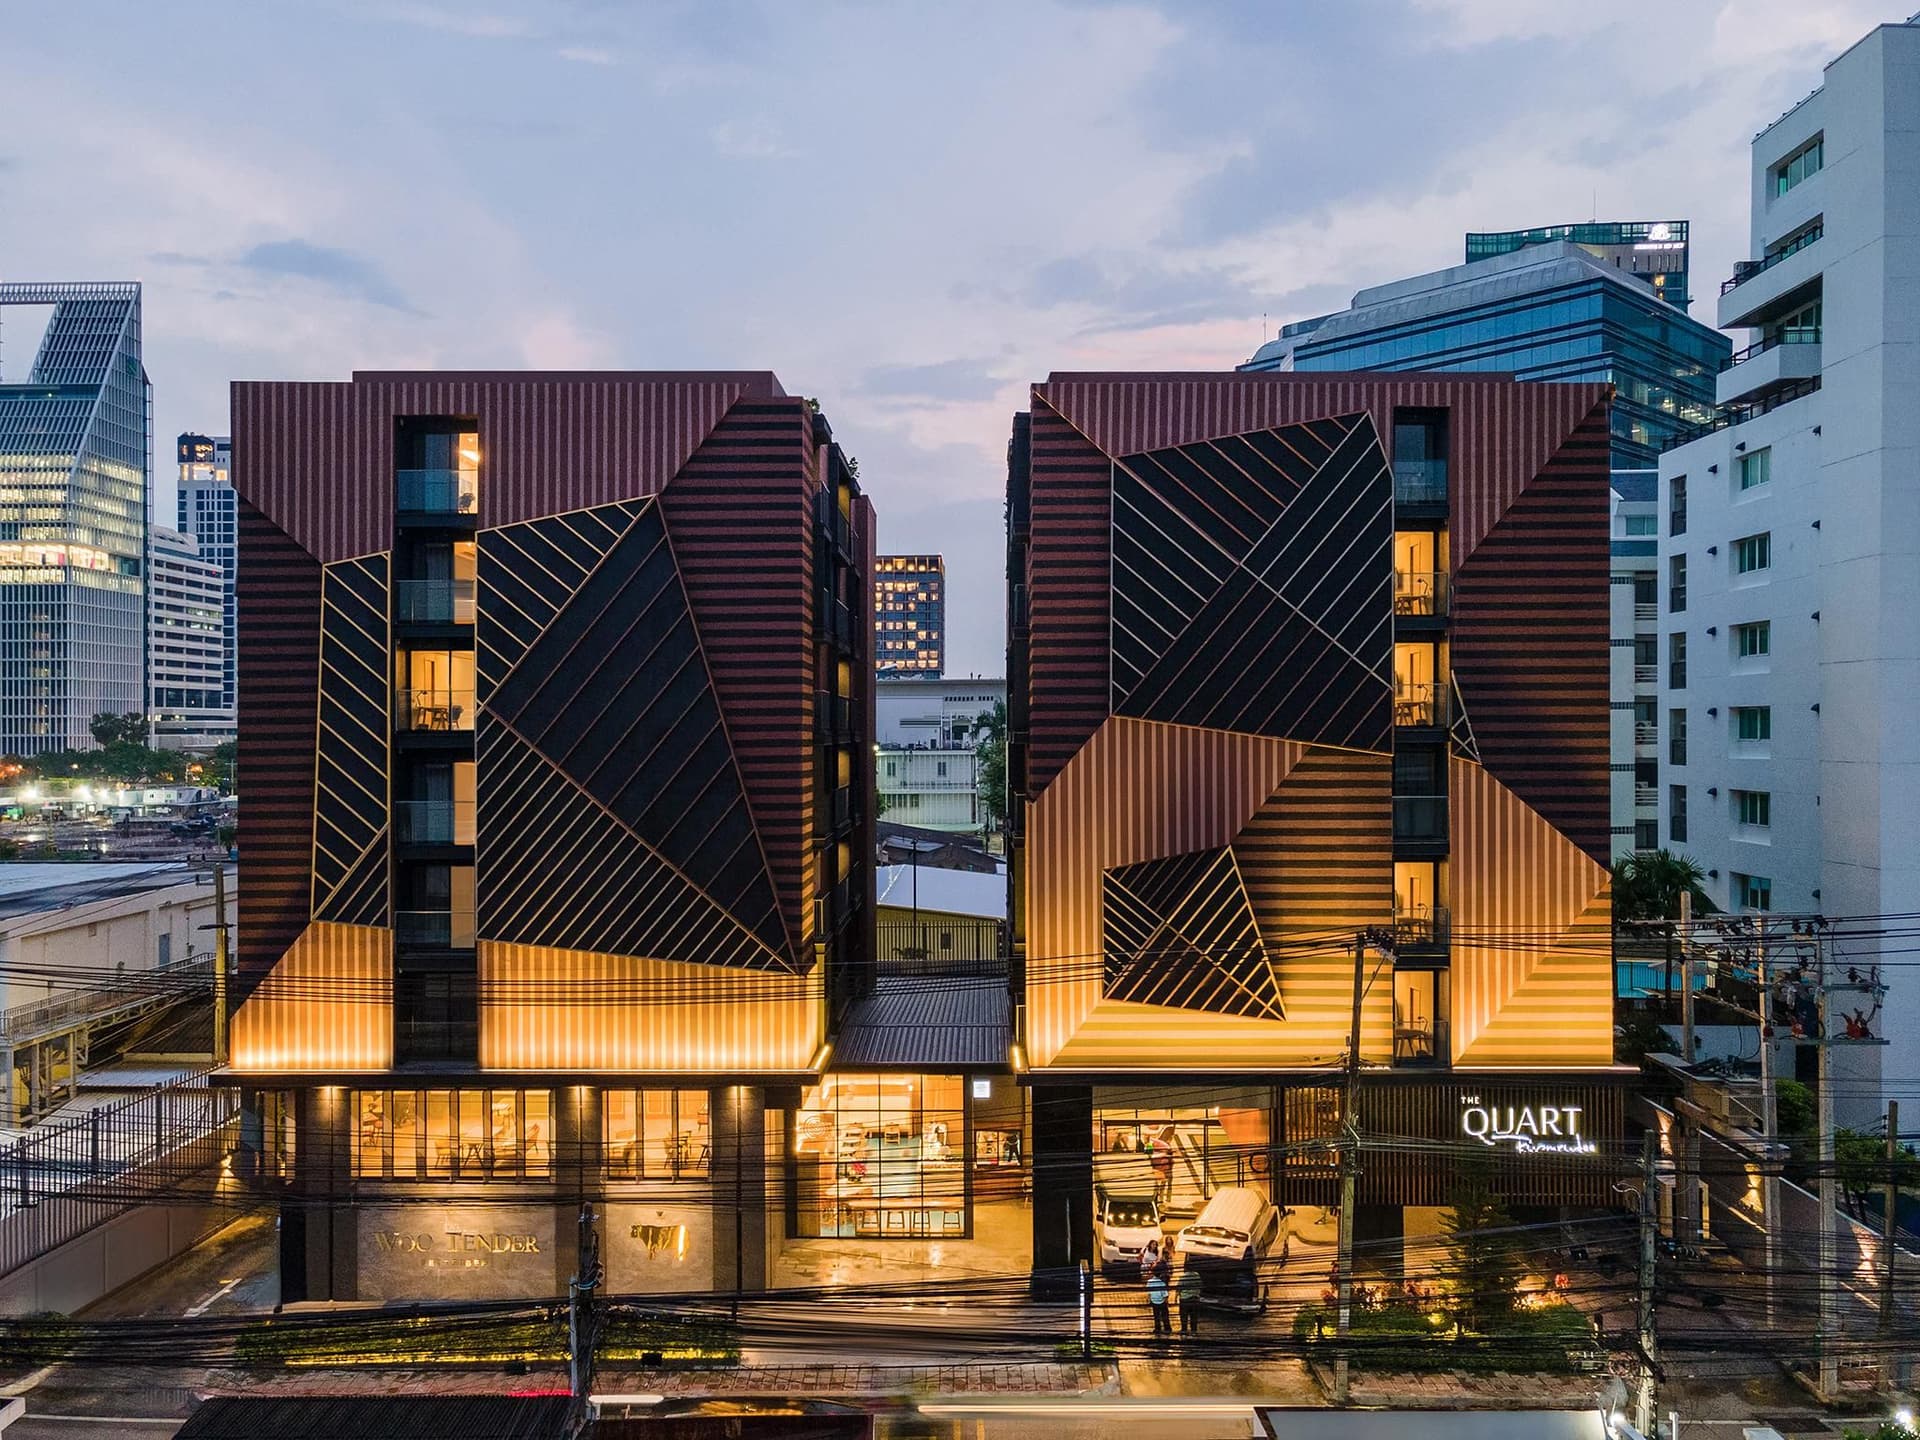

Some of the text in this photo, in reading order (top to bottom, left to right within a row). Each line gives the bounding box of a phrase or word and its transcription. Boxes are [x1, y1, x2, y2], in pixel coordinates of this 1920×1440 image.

[1460, 1096, 1480, 1105] THE
[1463, 1107, 1582, 1145] QUART
[374, 1231, 540, 1253] WOO TENDER
